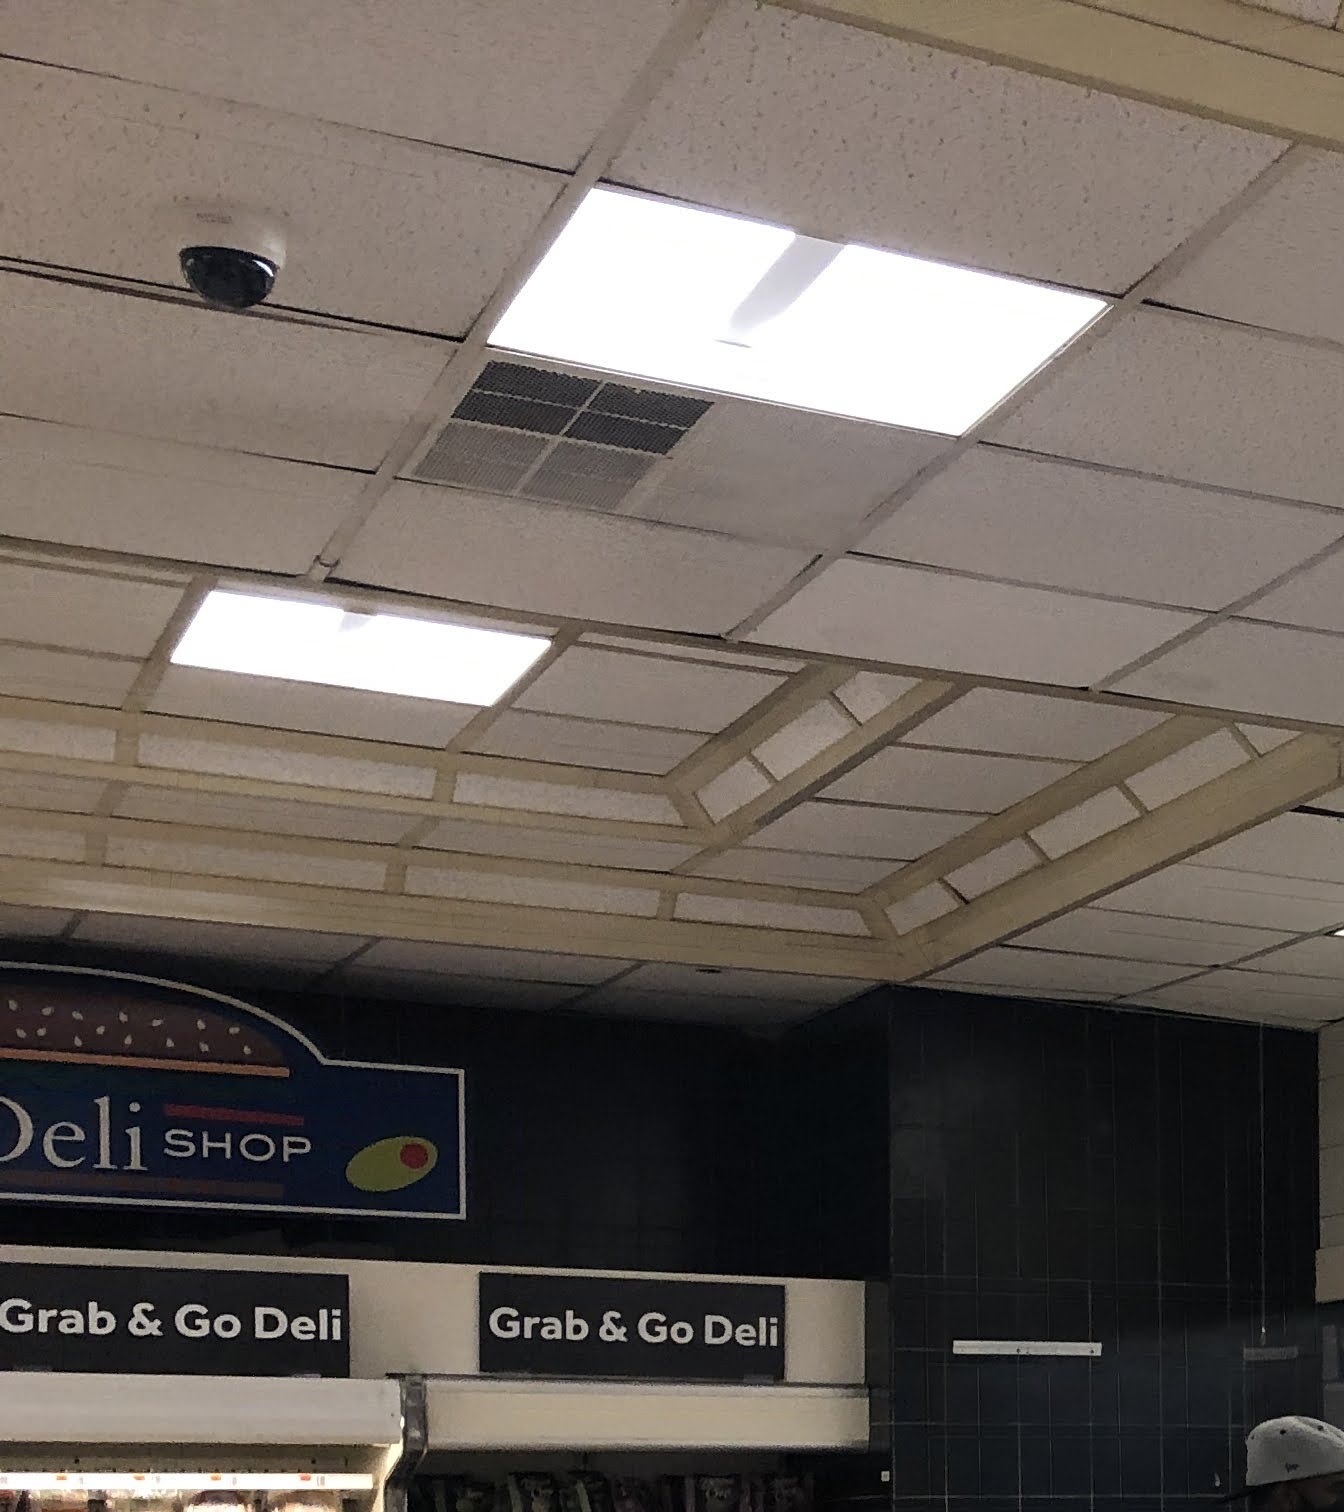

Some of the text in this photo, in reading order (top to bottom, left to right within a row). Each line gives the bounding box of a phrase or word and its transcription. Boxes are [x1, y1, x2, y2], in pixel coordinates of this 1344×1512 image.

[163, 1128, 313, 1165] SHOP
[0, 1298, 342, 1342] Grab & Go Deli
[488, 1307, 780, 1349] Grab & Go Deli
